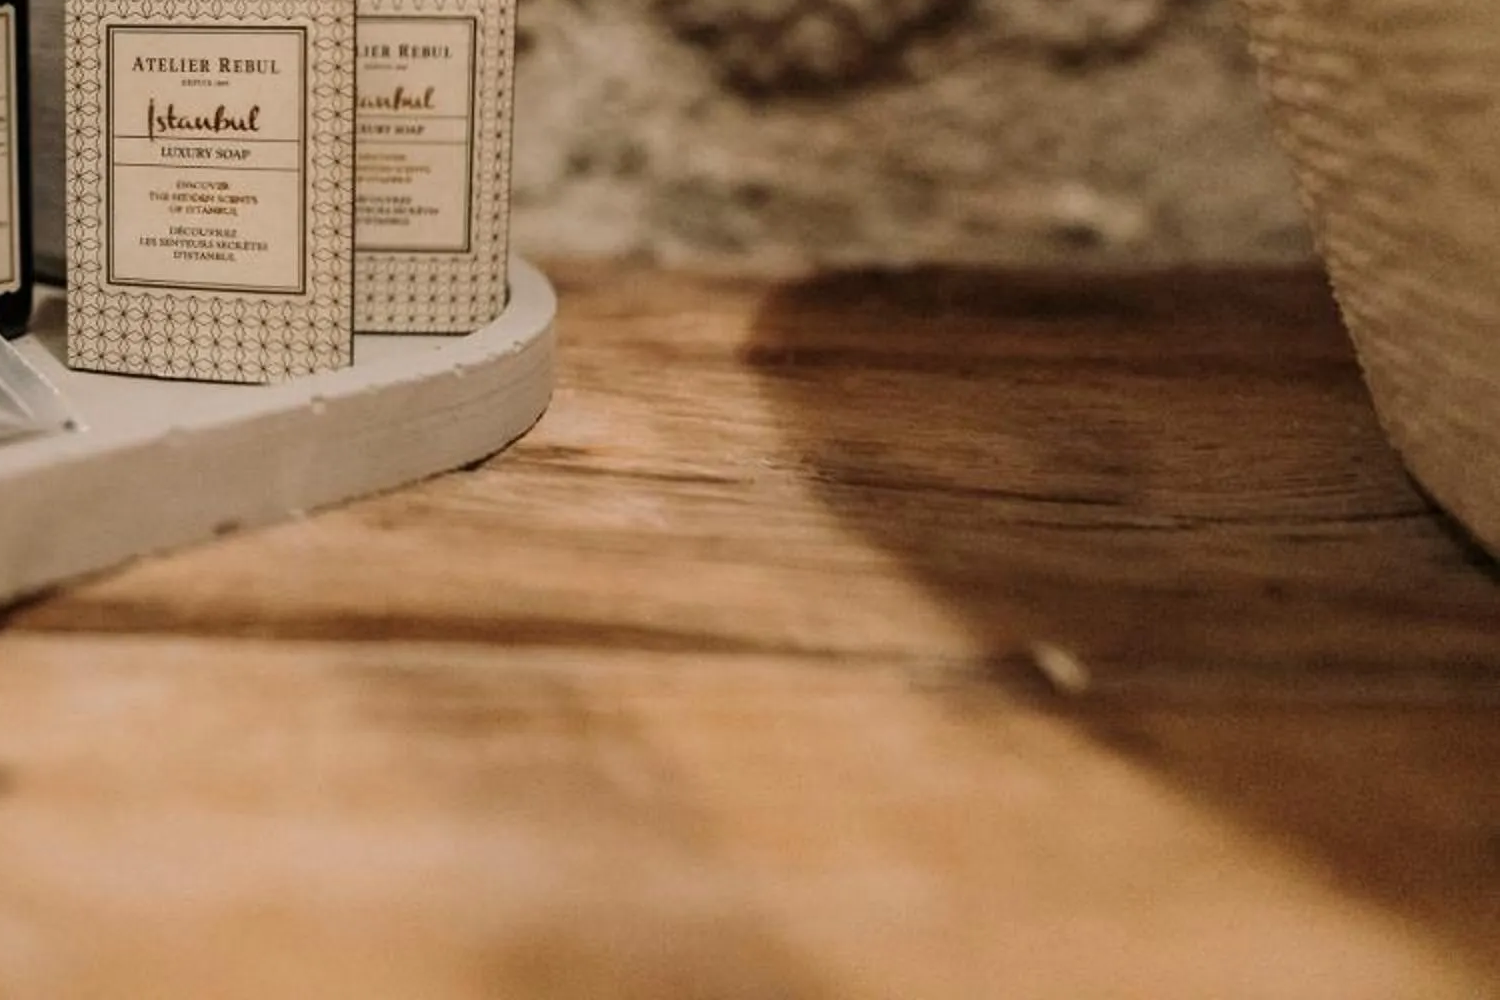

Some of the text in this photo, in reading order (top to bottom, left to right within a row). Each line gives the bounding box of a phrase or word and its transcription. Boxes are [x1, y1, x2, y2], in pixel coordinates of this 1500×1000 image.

[398, 44, 452, 59] REBUL
[131, 56, 281, 75] ATELIER REBUL
[161, 146, 252, 160] LUXURY SOAP
